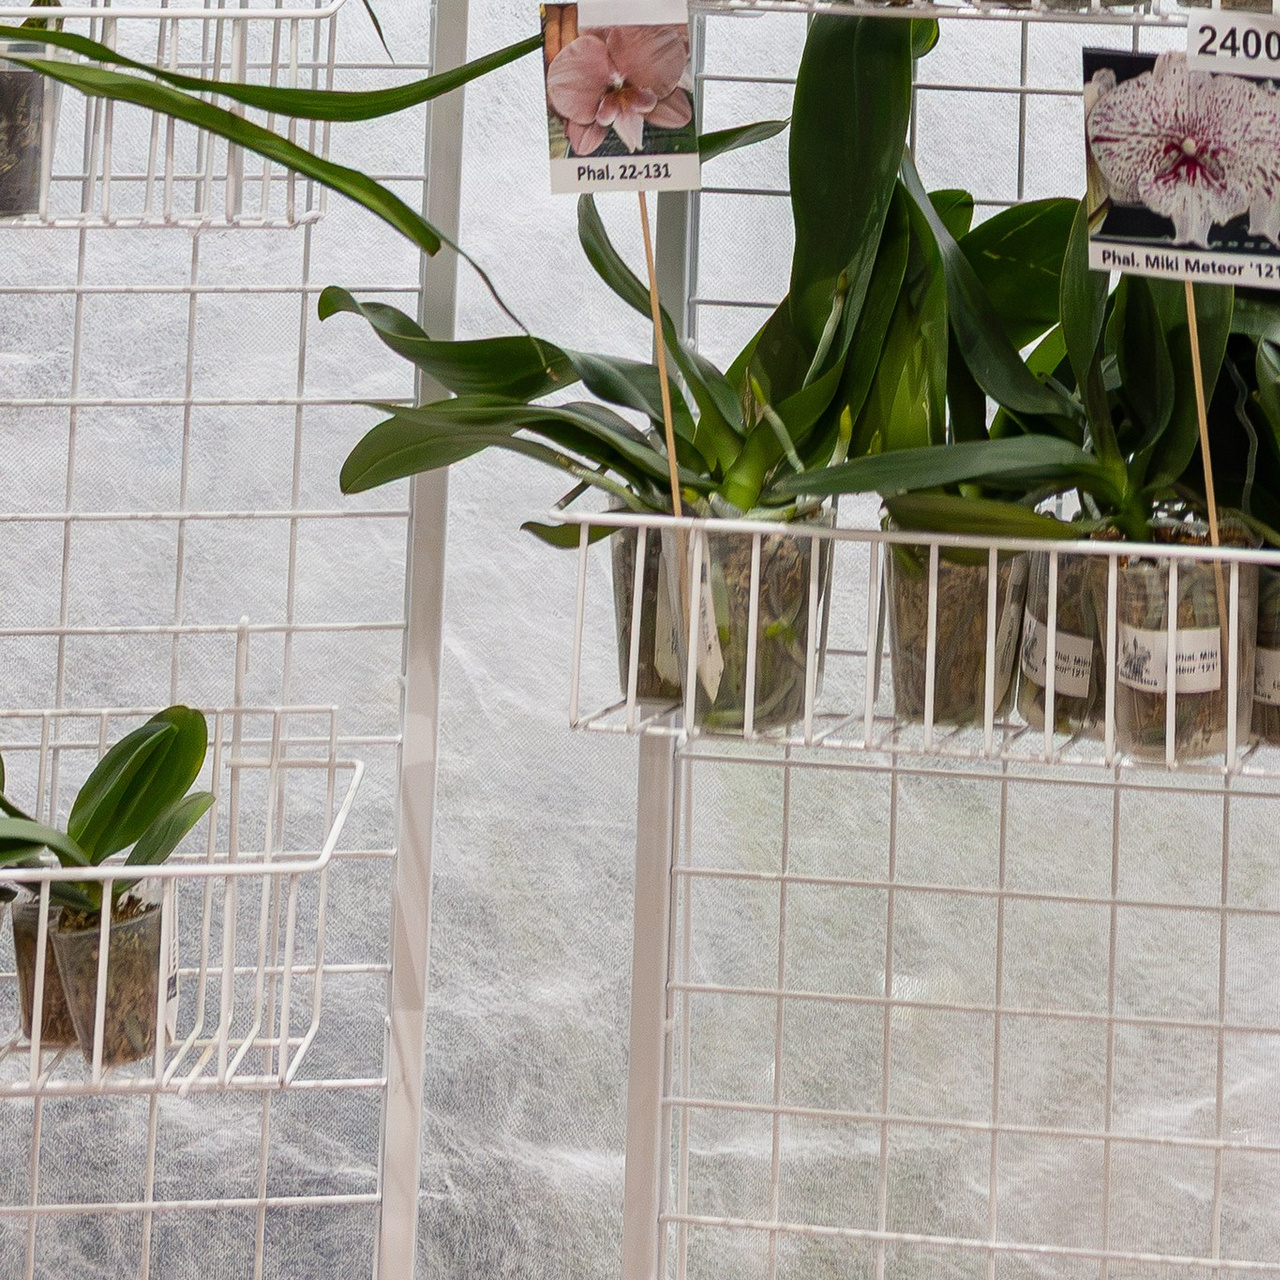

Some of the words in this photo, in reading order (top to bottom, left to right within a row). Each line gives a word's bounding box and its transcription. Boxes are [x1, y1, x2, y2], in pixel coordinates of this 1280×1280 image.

[577, 165, 614, 181] Phal.
[619, 163, 672, 180] 22-131
[1101, 250, 1140, 268] Phal.
[1145, 255, 1180, 272] Miki
[1185, 258, 1246, 277] Meteor
